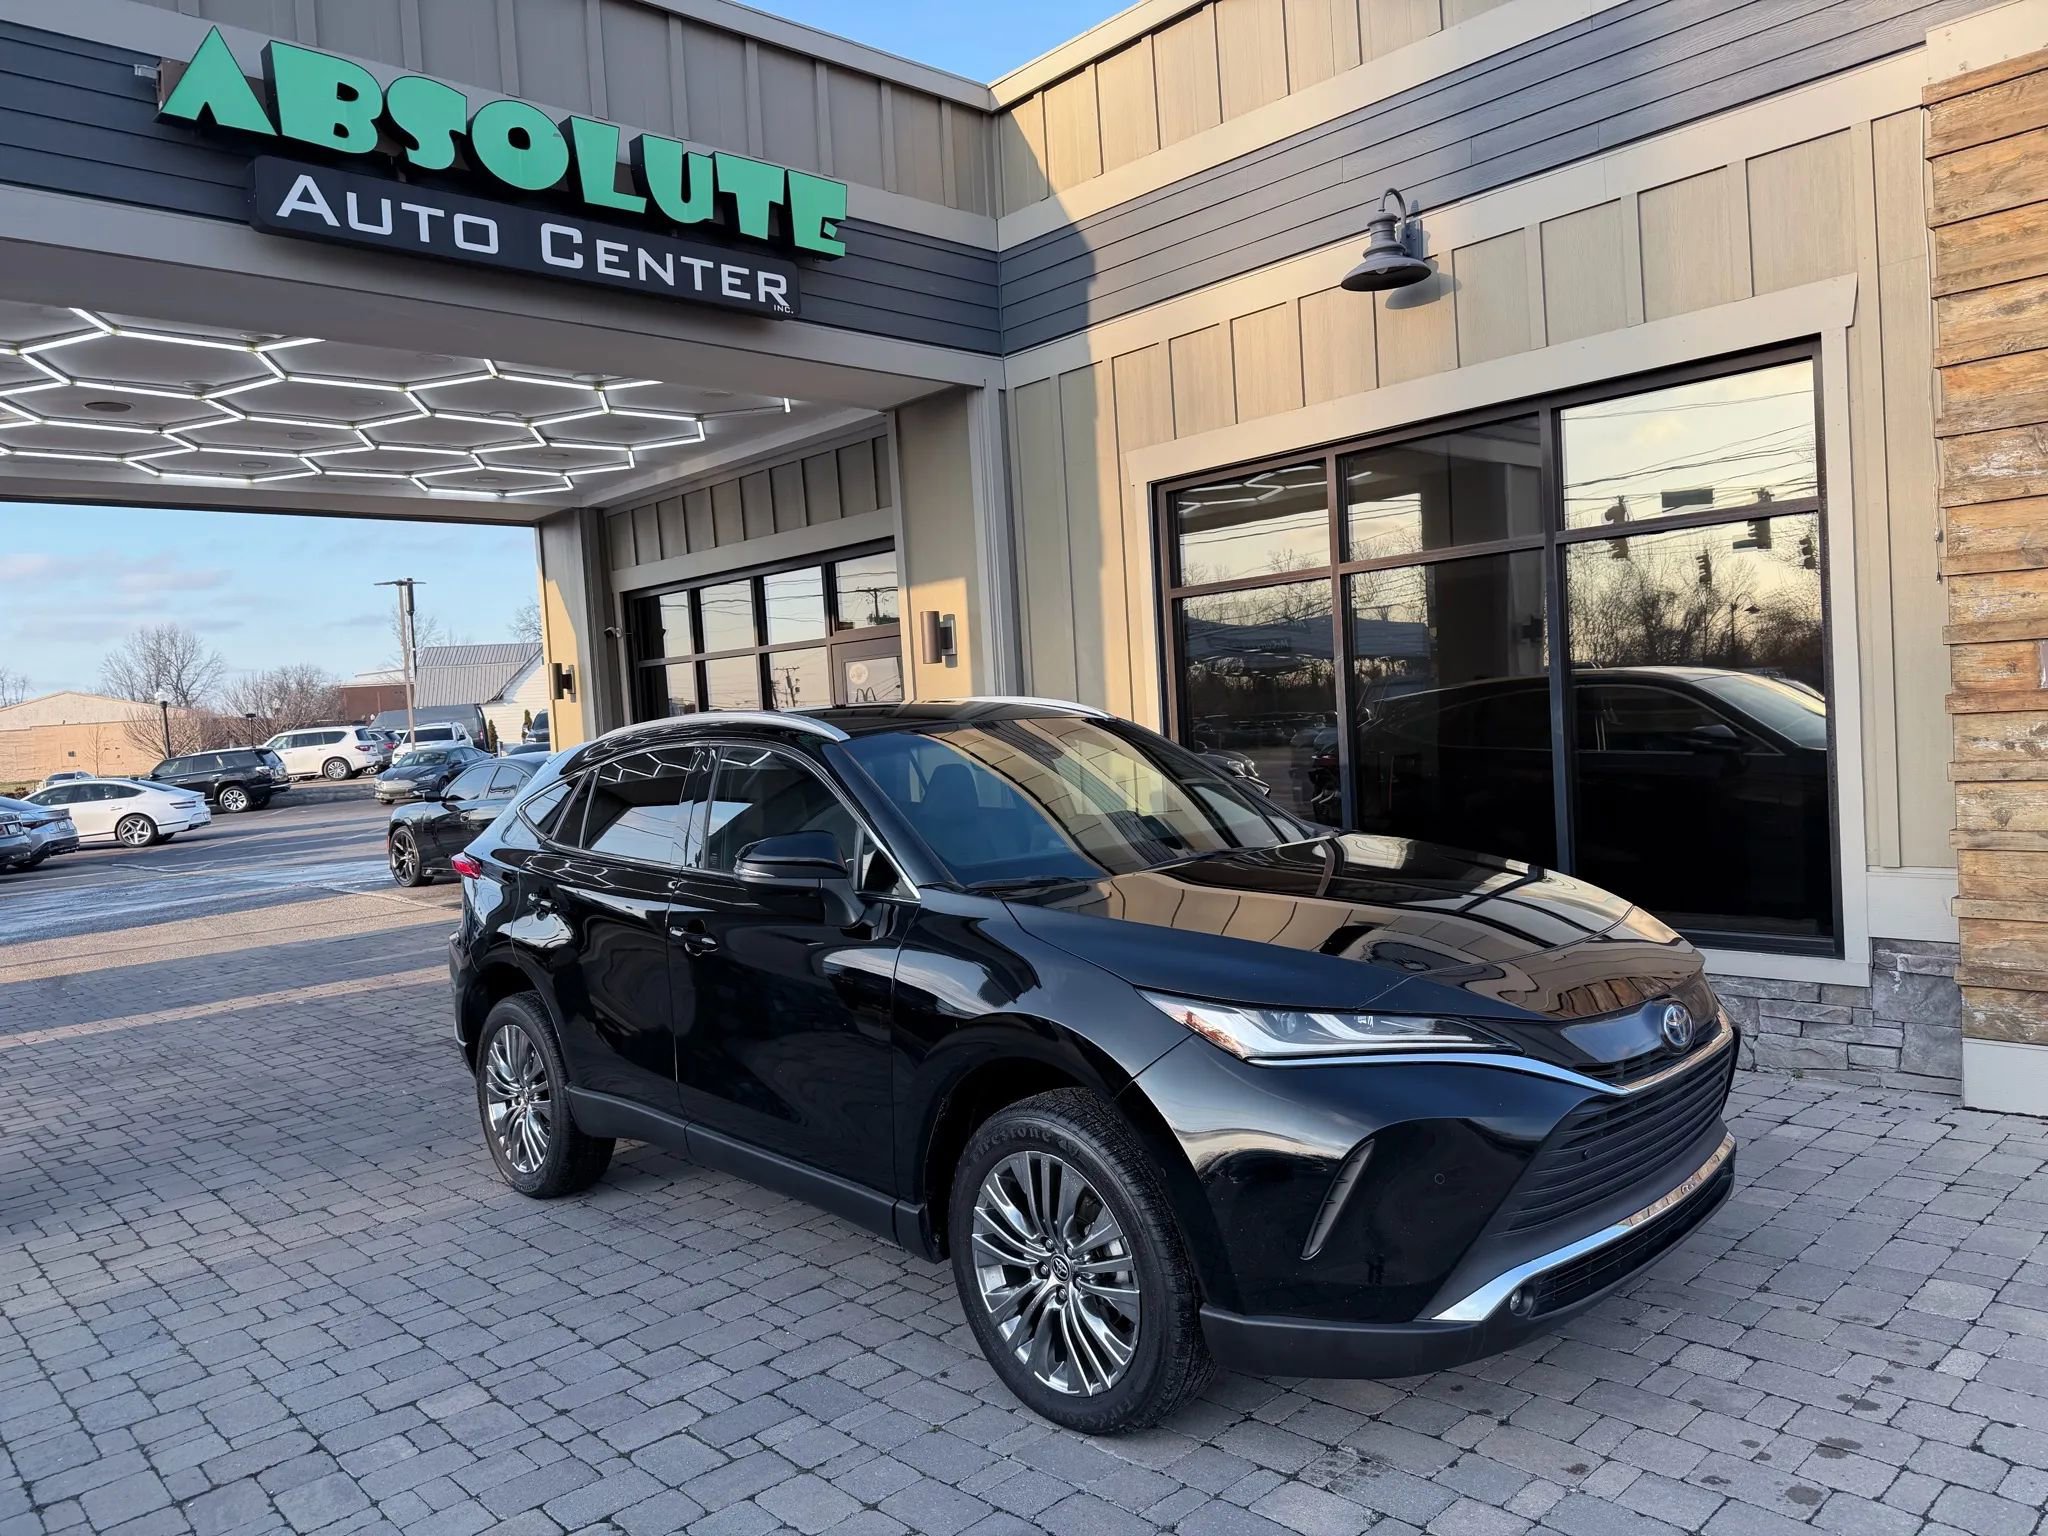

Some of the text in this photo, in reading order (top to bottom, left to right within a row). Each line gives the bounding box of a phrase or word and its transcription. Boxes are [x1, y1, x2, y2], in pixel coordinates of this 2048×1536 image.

[159, 25, 847, 257] ABSOLUTE
[275, 174, 790, 307] AUTO CENTER
[773, 304, 794, 314] INC.
